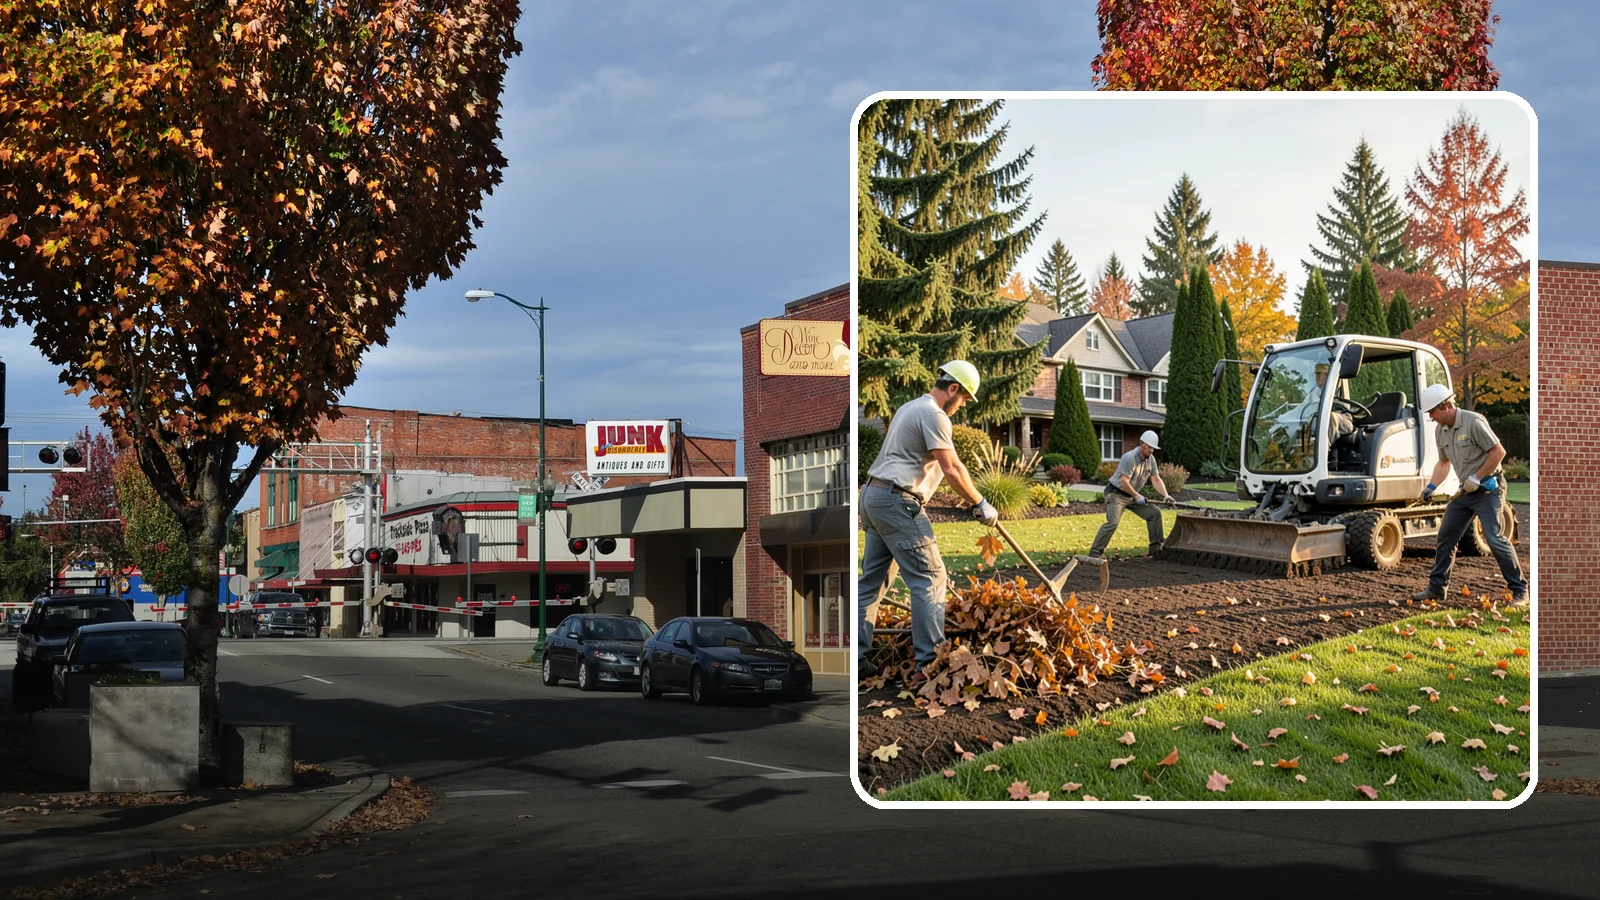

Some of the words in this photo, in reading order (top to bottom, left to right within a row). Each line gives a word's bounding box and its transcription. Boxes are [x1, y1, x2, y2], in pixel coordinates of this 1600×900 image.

[595, 425, 665, 457] JUNK
[607, 446, 646, 454] DISORDERLY
[597, 461, 628, 470] ANTIQUES
[631, 461, 644, 470] AND
[647, 460, 665, 469] GIFTS
[415, 519, 429, 535] Pizza
